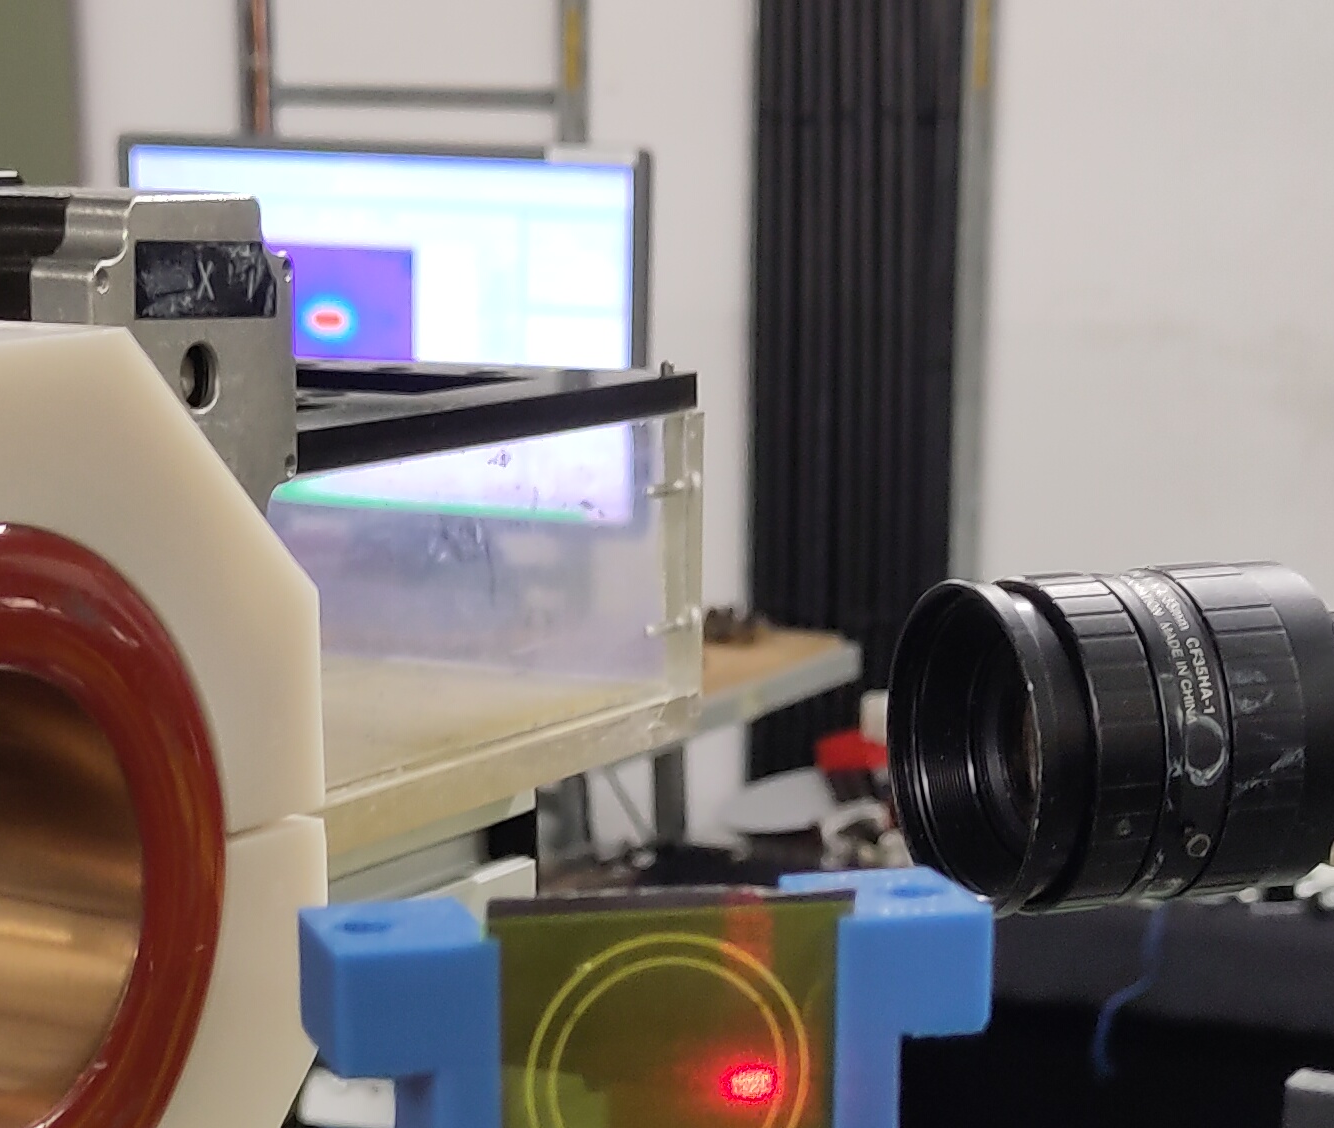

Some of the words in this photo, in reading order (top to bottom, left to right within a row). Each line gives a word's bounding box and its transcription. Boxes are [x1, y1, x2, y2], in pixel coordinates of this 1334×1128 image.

[1159, 621, 1184, 659] MADE
[1175, 660, 1190, 677] IN
[1186, 637, 1216, 714] CF35HA-1
[1180, 679, 1198, 725] CHINA
